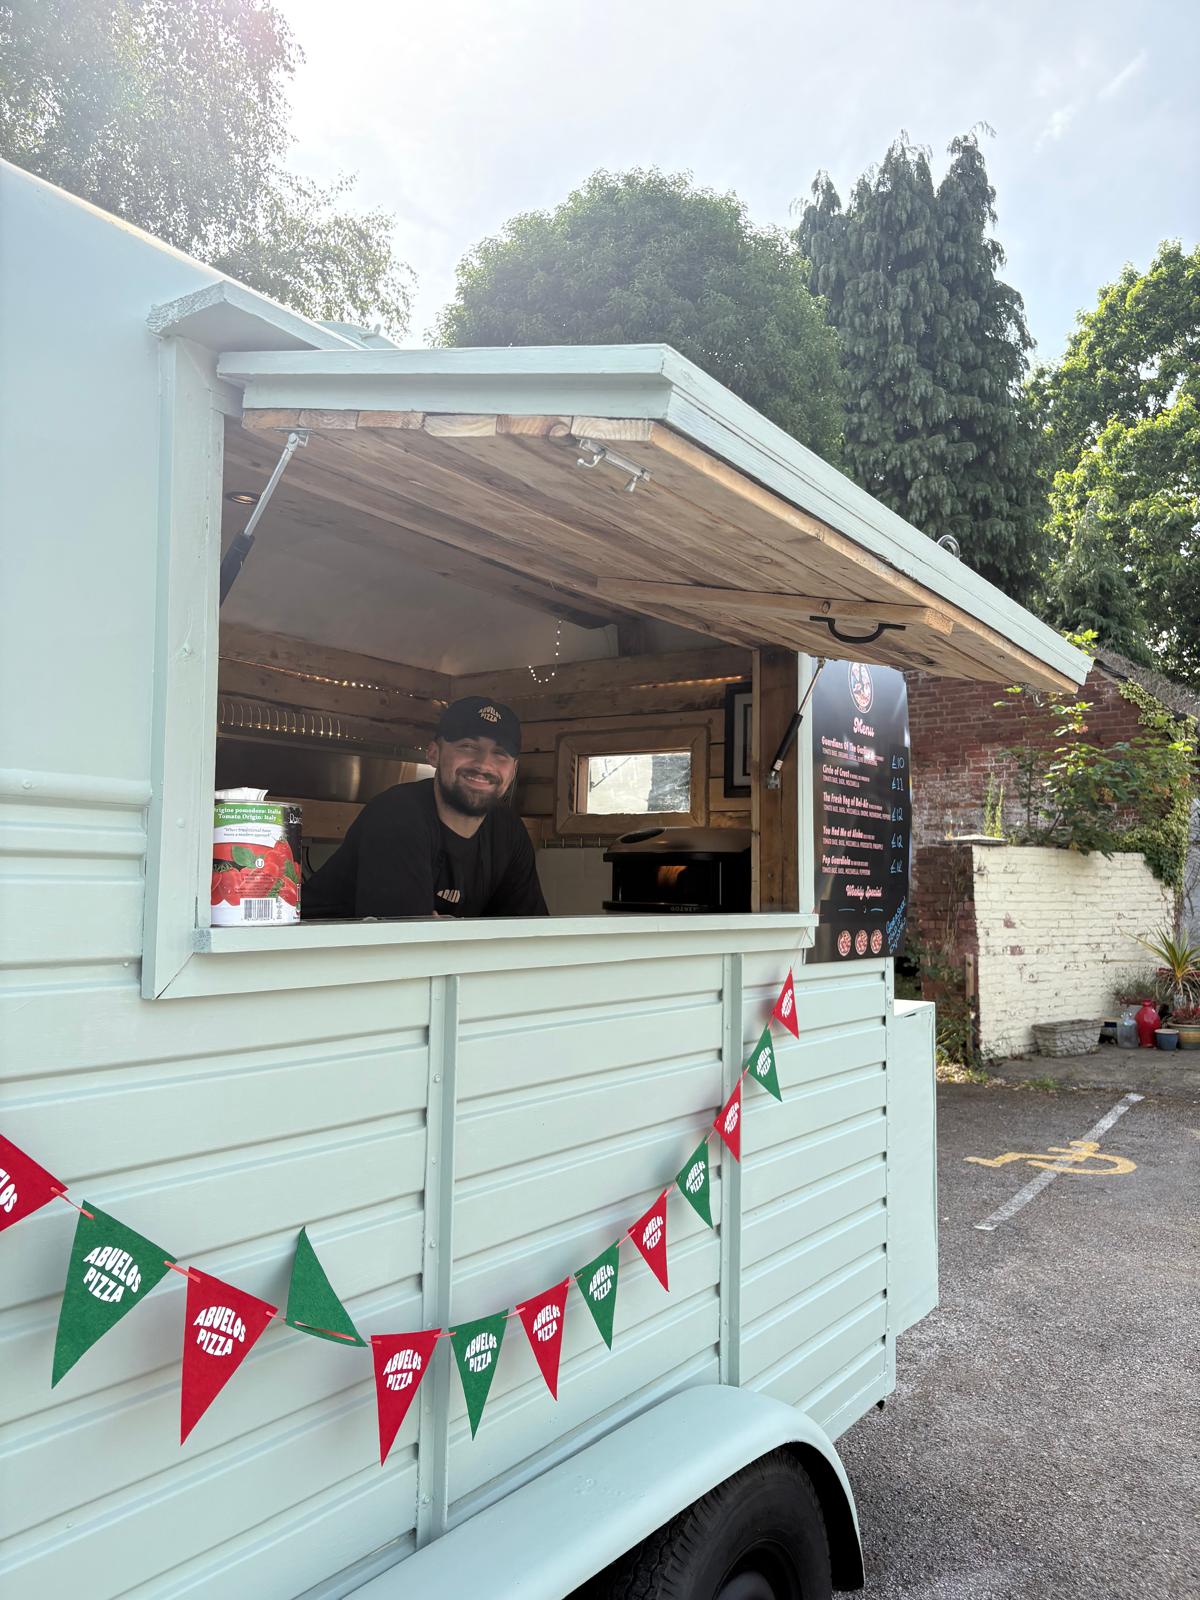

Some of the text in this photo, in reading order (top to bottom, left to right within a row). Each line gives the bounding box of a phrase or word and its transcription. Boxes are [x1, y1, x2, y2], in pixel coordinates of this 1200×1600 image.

[480, 713, 497, 722] PIZZA
[853, 717, 874, 737] Menu
[892, 755, 904, 769] £10
[892, 777, 904, 790] £11
[840, 828, 846, 836] Me
[760, 1056, 771, 1078] PIZZA
[686, 1160, 706, 1190] ABUELOS
[690, 1172, 704, 1194] PIZZA
[642, 1216, 664, 1246] ABUELOS
[646, 1228, 662, 1250] PIZZA
[83, 1246, 141, 1292] ABUELOS
[589, 1264, 614, 1295] ABUELOS
[83, 1266, 125, 1302] PIZZA
[594, 1278, 612, 1301] PIZZA
[193, 1306, 246, 1342] ABUELOS
[532, 1304, 560, 1334] ABUELOS
[196, 1328, 234, 1356] PIZZA
[537, 1320, 558, 1342] PIZZA
[464, 1332, 497, 1362] ABUELOS
[383, 1349, 422, 1376] ABUELOS
[470, 1350, 492, 1372] PIZZA
[386, 1371, 412, 1390] PIZZA
